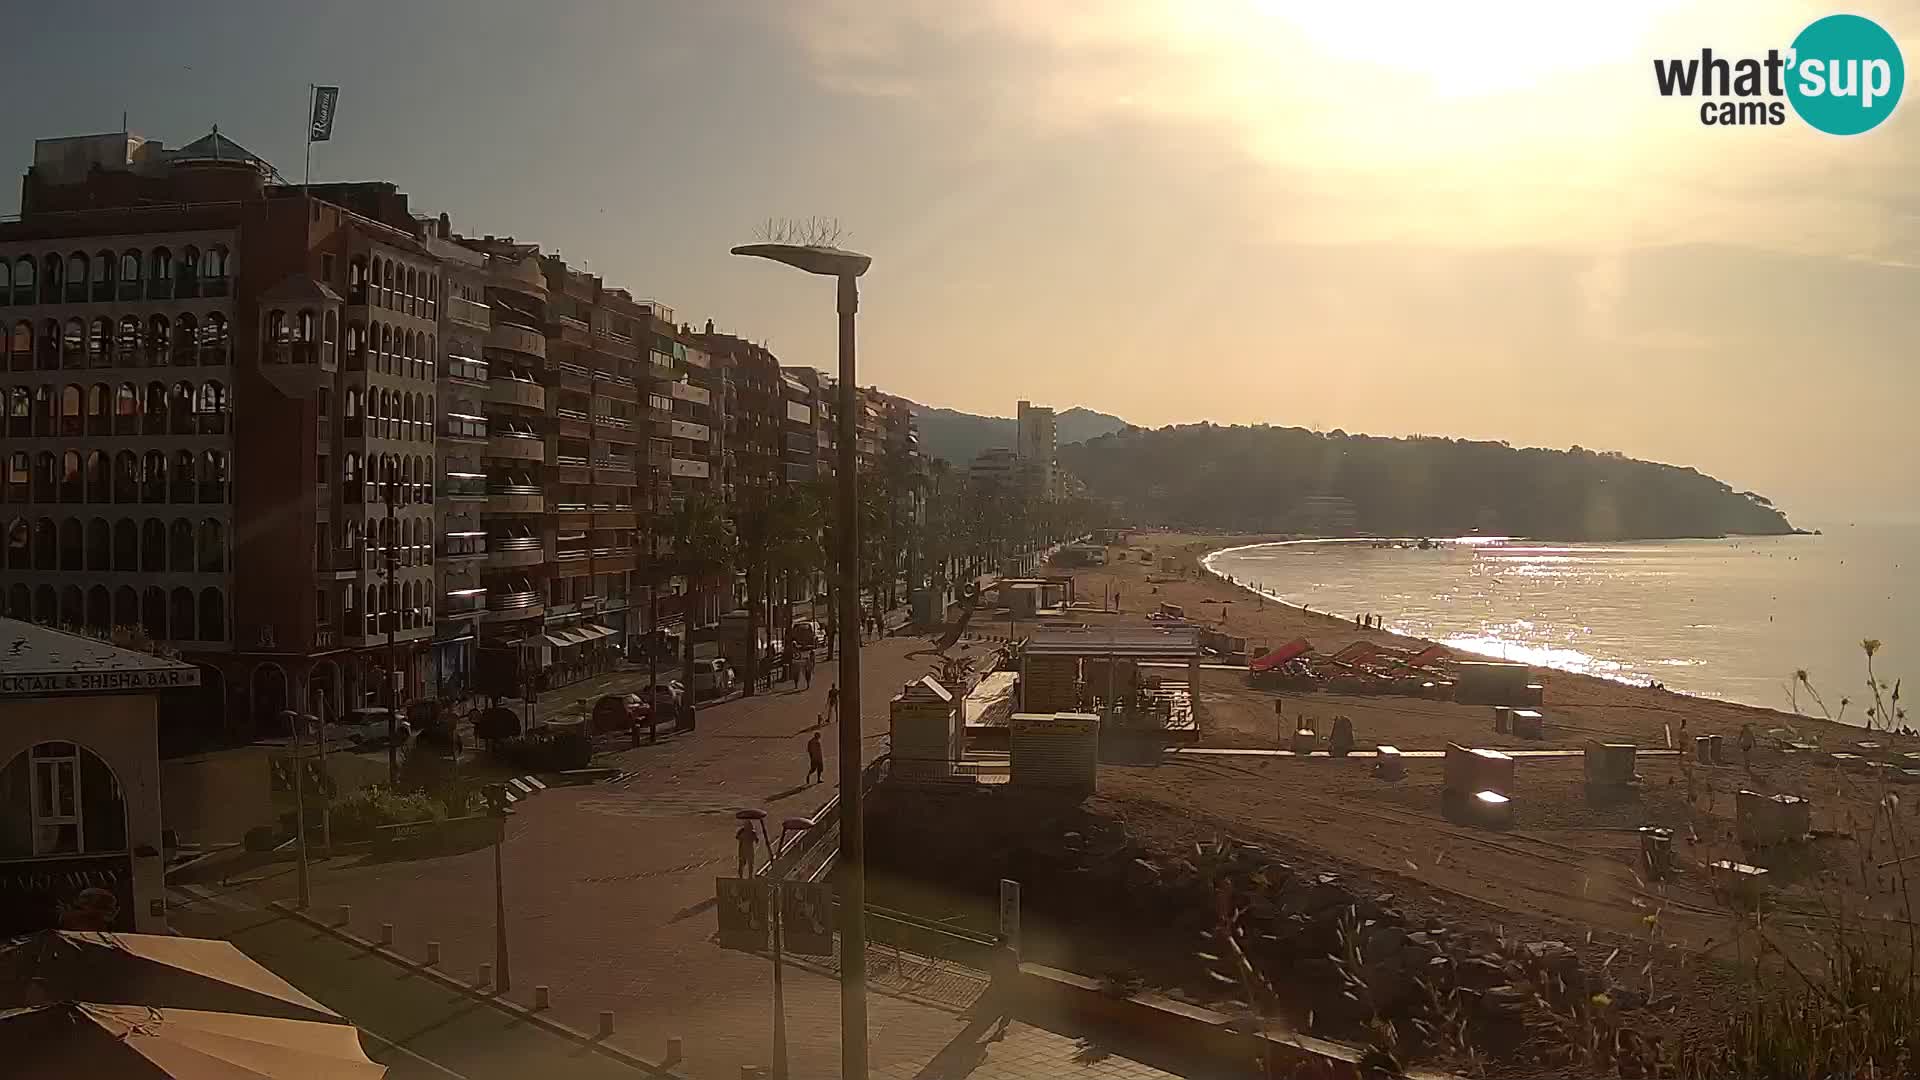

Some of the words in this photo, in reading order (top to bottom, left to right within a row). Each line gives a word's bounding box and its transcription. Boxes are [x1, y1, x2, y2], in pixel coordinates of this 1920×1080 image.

[0, 675, 60, 691] CKTAIL
[81, 674, 140, 689] SHISHA
[146, 672, 178, 686] BAR
